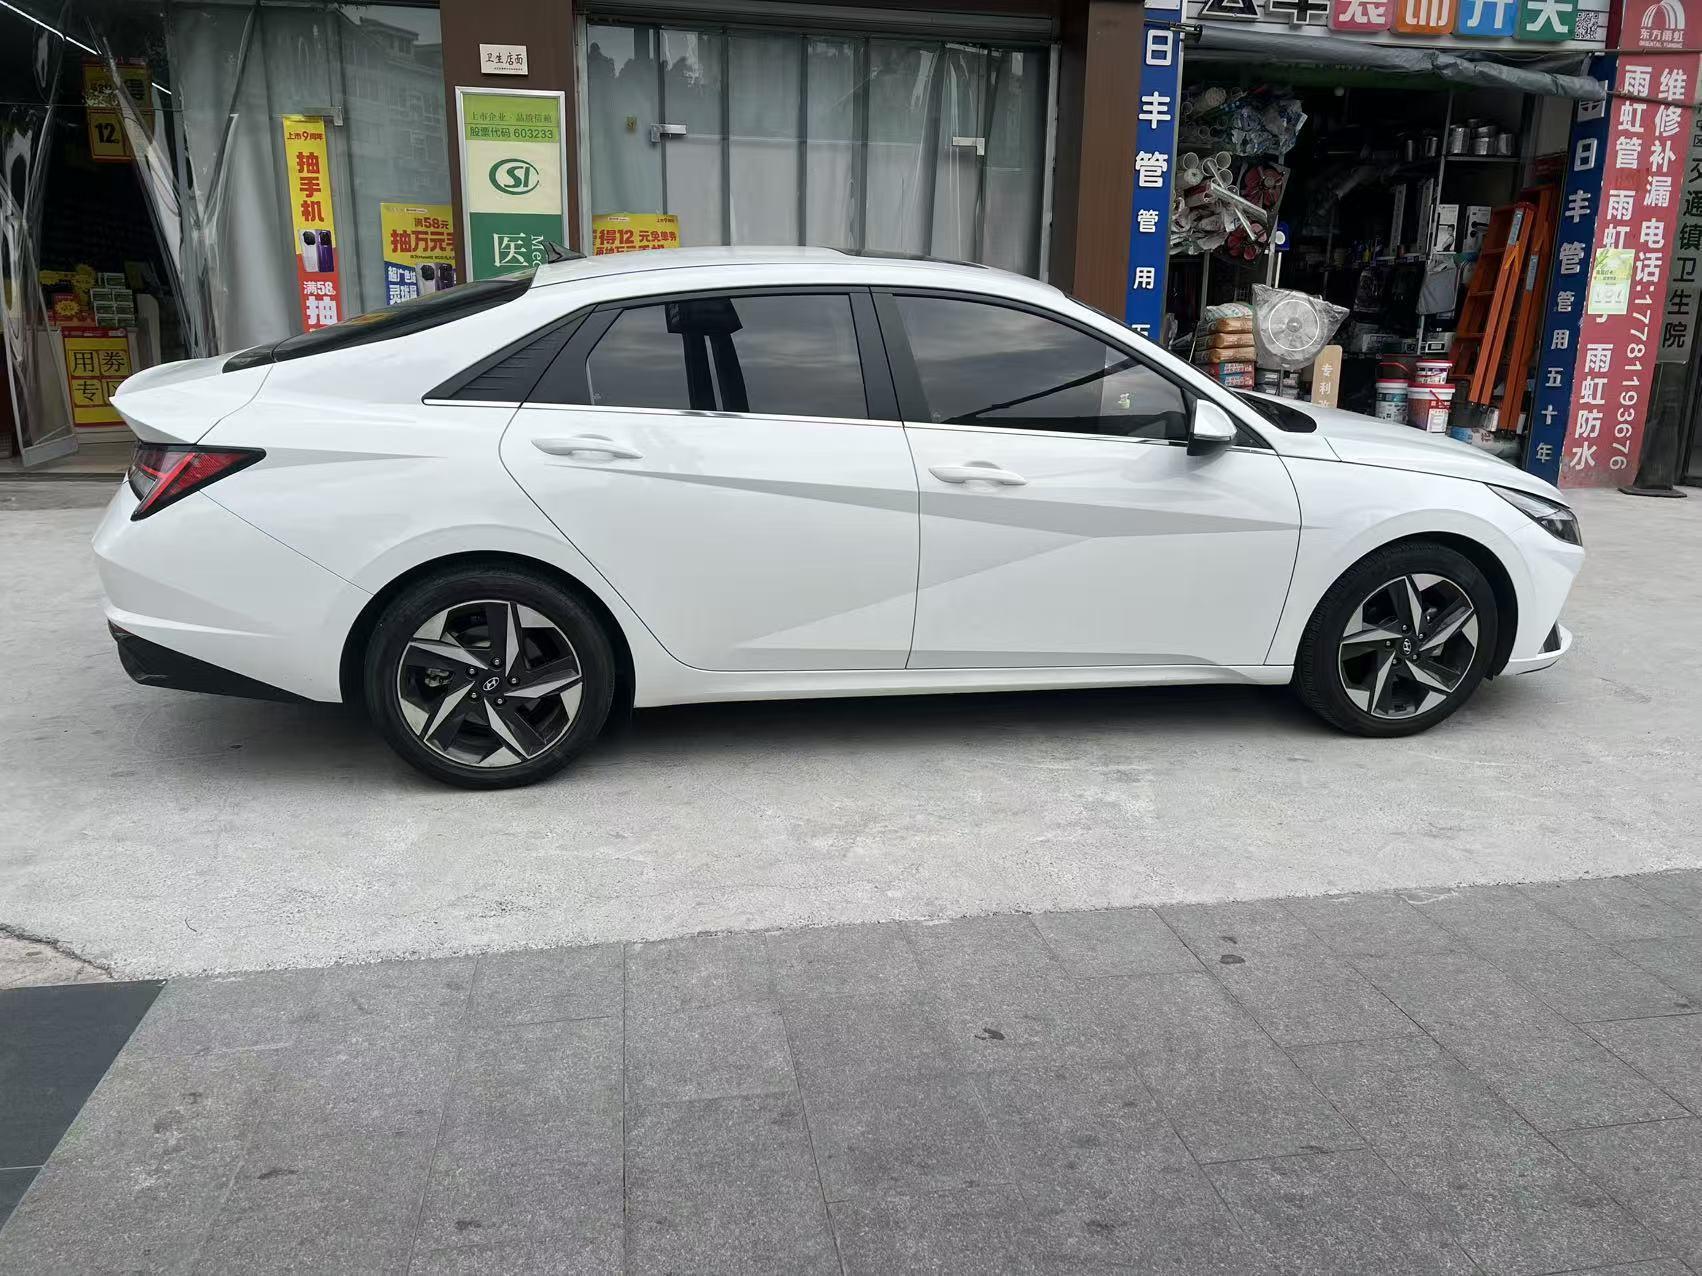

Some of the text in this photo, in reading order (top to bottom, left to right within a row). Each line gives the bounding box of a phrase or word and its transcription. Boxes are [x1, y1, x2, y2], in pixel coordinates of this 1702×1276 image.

[485, 52, 524, 65] 卫生店面
[1640, 29, 1684, 41] 东方雨虹
[469, 126, 553, 139] 股票代码 603233
[1135, 30, 1173, 188] 日丰管
[1616, 66, 1652, 169] 雨虹管
[1643, 69, 1687, 207] 维修补漏
[296, 151, 325, 223] 抽手机
[493, 232, 529, 267] 医
[306, 296, 338, 325] 抽
[1536, 137, 1599, 464] 日丰管 管用五十年
[1569, 344, 1613, 471] 雨虹防水
